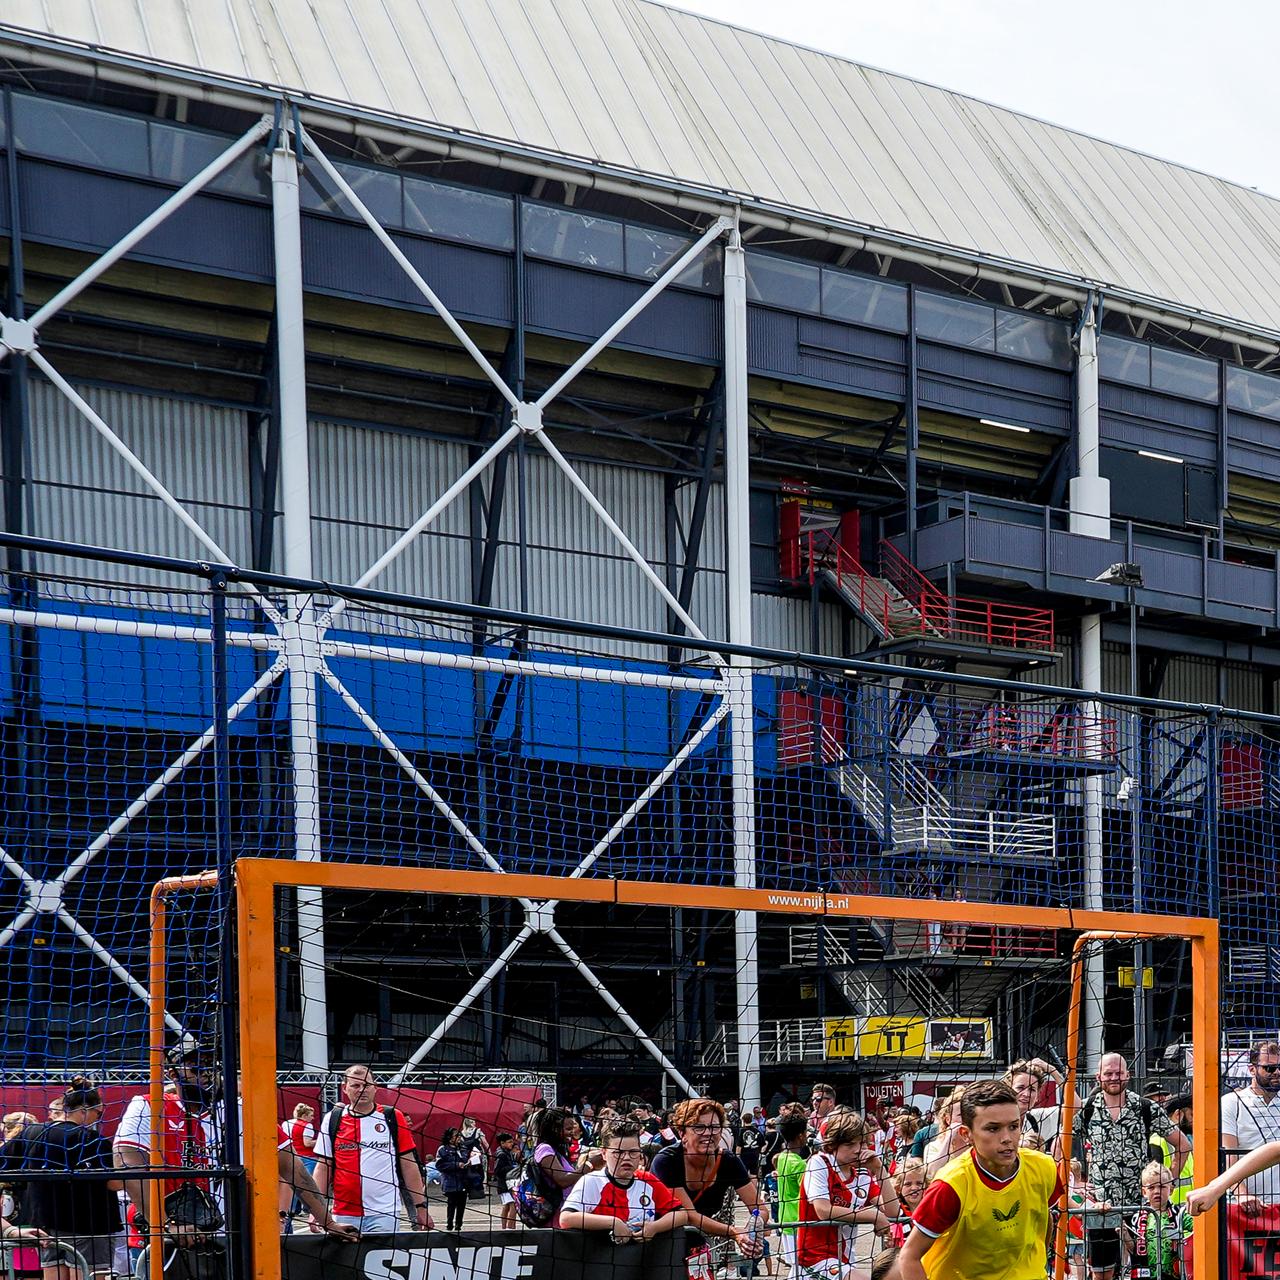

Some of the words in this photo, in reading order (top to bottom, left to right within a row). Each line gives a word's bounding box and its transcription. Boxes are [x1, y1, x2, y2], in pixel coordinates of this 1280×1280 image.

[768, 894, 849, 909] www.nijha.nl
[883, 1031, 908, 1052] TT
[866, 1085, 903, 1098] TOILETTEN
